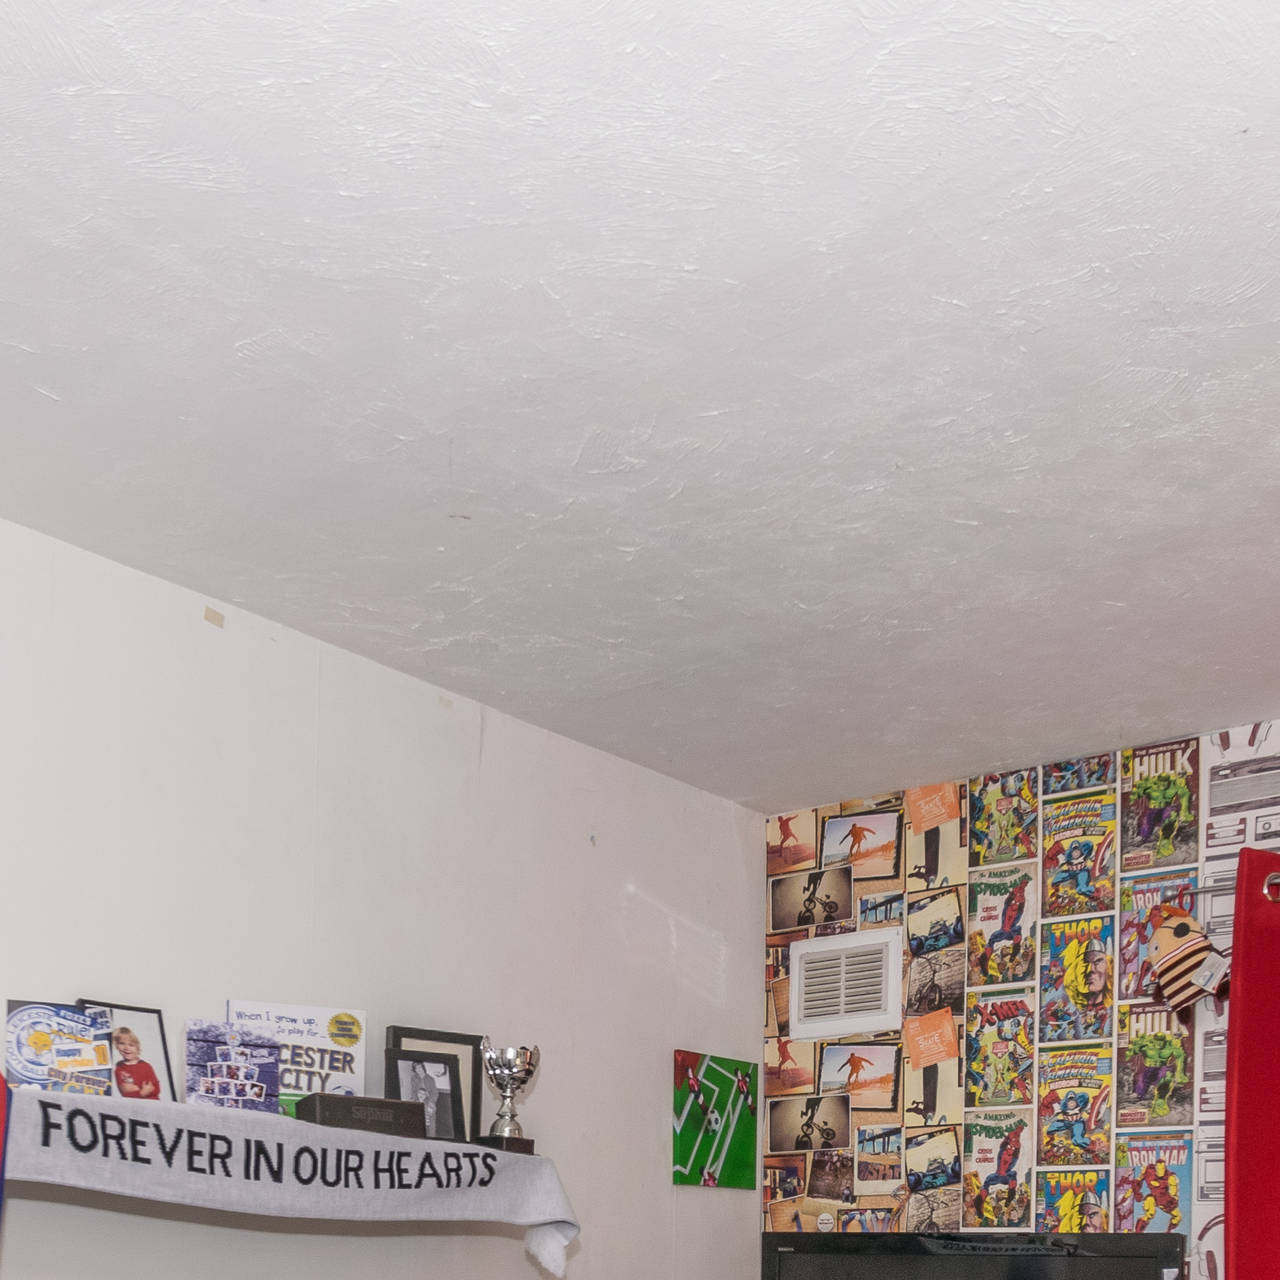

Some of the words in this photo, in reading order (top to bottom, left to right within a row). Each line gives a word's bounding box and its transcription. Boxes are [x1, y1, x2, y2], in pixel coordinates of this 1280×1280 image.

[1133, 747, 1194, 784] HULK
[1051, 918, 1103, 947] THOR
[275, 1015, 297, 1023] grow
[280, 1068, 331, 1093] CITY
[38, 1100, 232, 1178] FOREVER
[243, 1139, 284, 1184] IN
[293, 1145, 365, 1189] OUR
[373, 1150, 498, 1190] HEARTS
[1128, 1146, 1157, 1167] IRON
[1047, 1171, 1098, 1195] THOR
